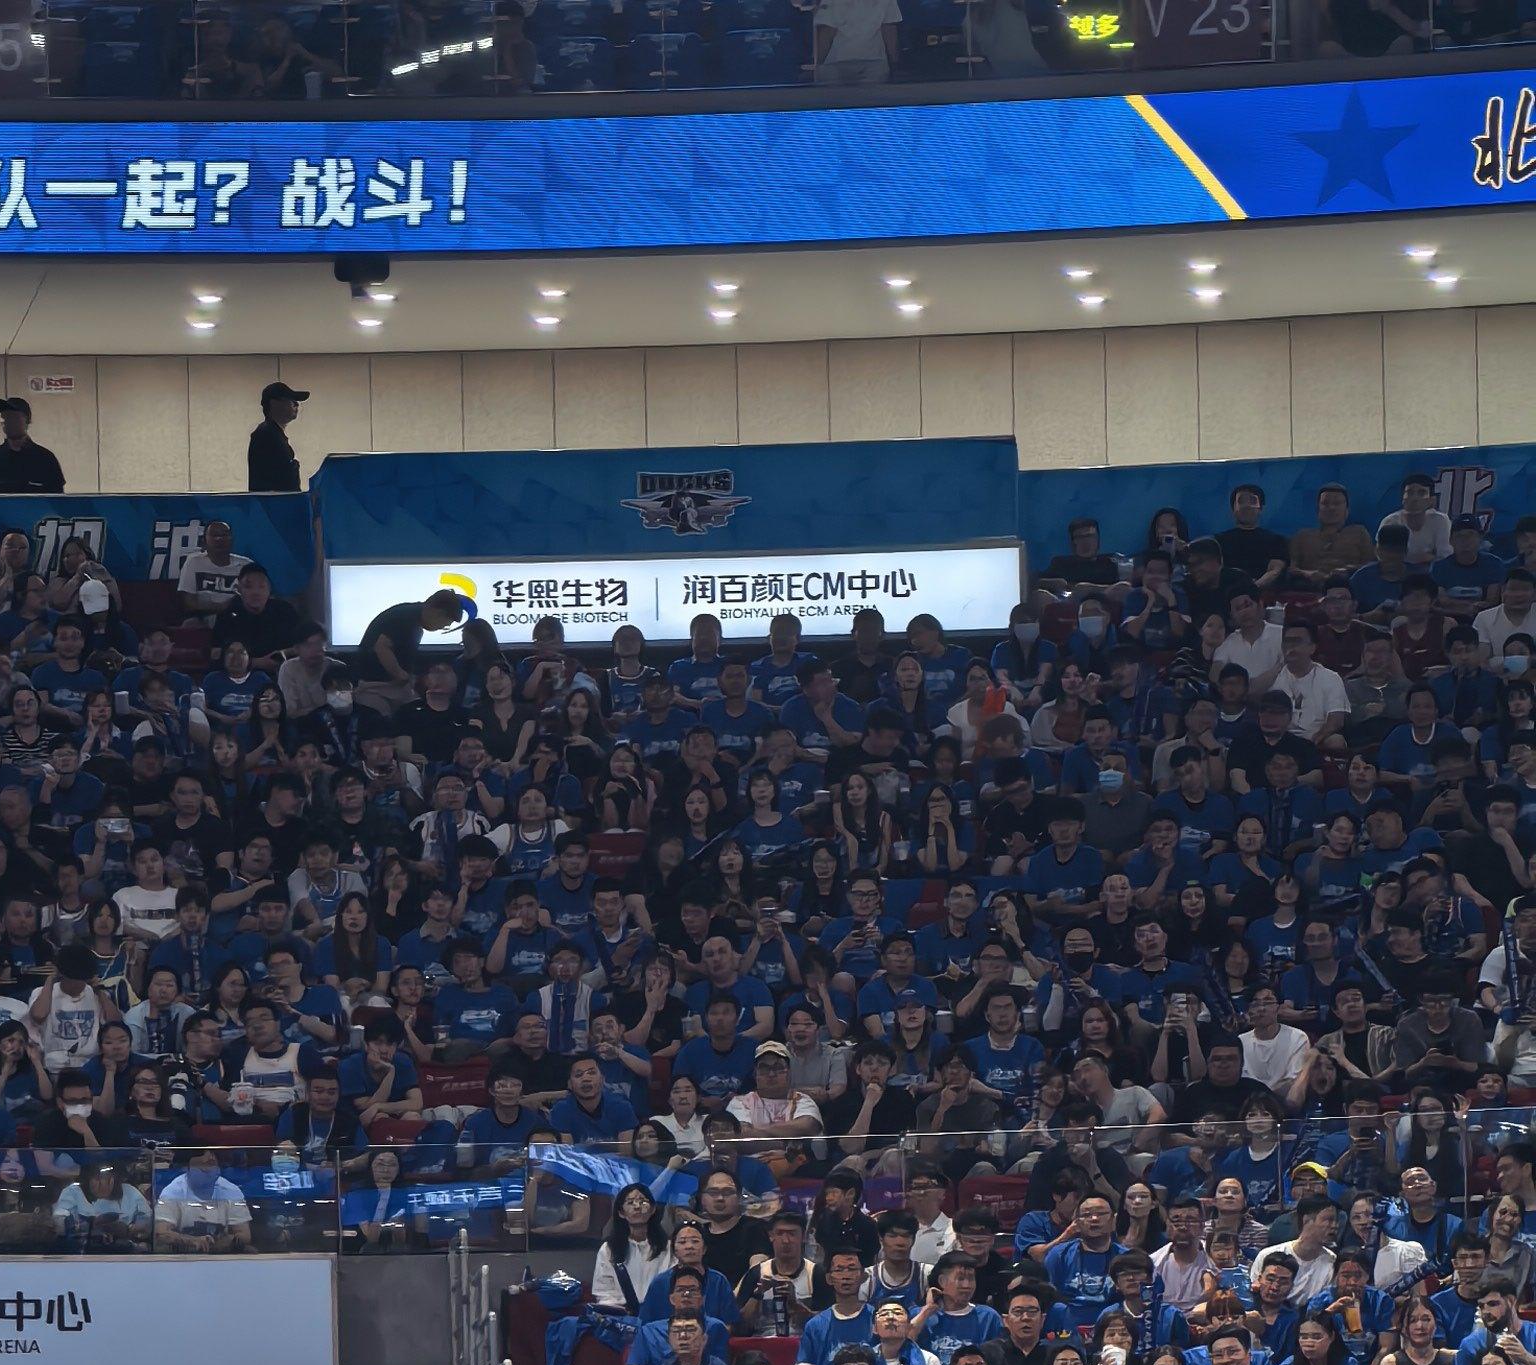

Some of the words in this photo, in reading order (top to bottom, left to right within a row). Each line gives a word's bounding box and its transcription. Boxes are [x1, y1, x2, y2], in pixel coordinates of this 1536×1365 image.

[492, 576, 629, 609] 华熙生物
[682, 568, 918, 605] 润百颜ECM中心
[492, 611, 569, 625] BLOOMGE
[572, 610, 628, 624] BIOTECH
[798, 605, 830, 618] ECM
